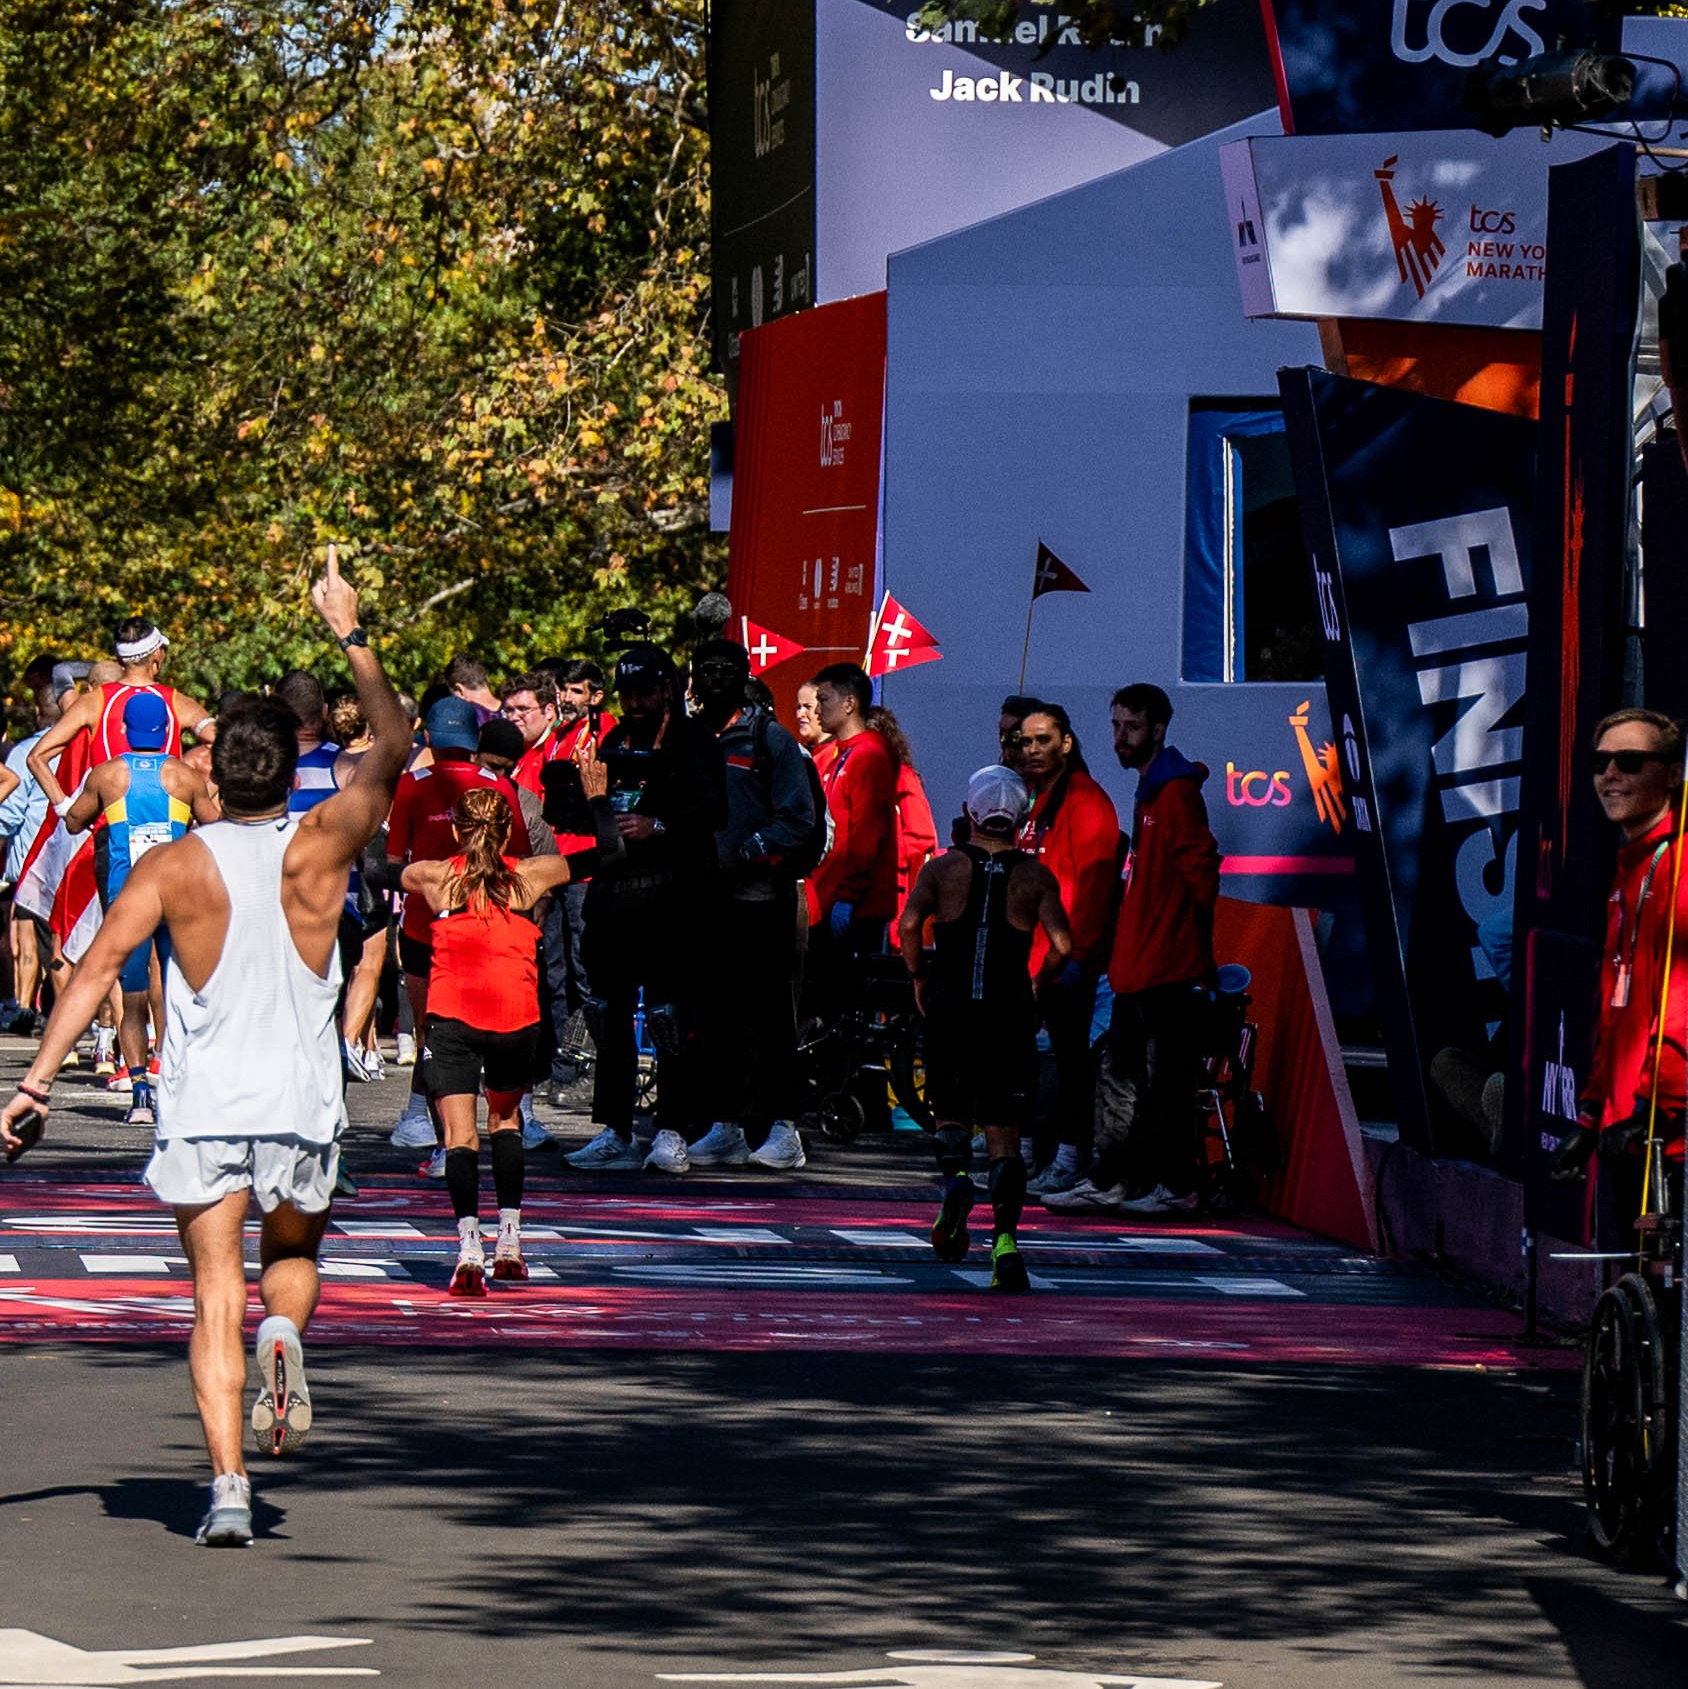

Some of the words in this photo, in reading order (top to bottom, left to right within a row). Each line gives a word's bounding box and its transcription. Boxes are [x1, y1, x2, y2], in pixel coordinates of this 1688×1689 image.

[929, 69, 1024, 103] Jack
[1029, 71, 1141, 104] Rudin
[1469, 204, 1517, 234] tcs
[1467, 241, 1513, 258] NEW
[1225, 759, 1293, 808] tcs
